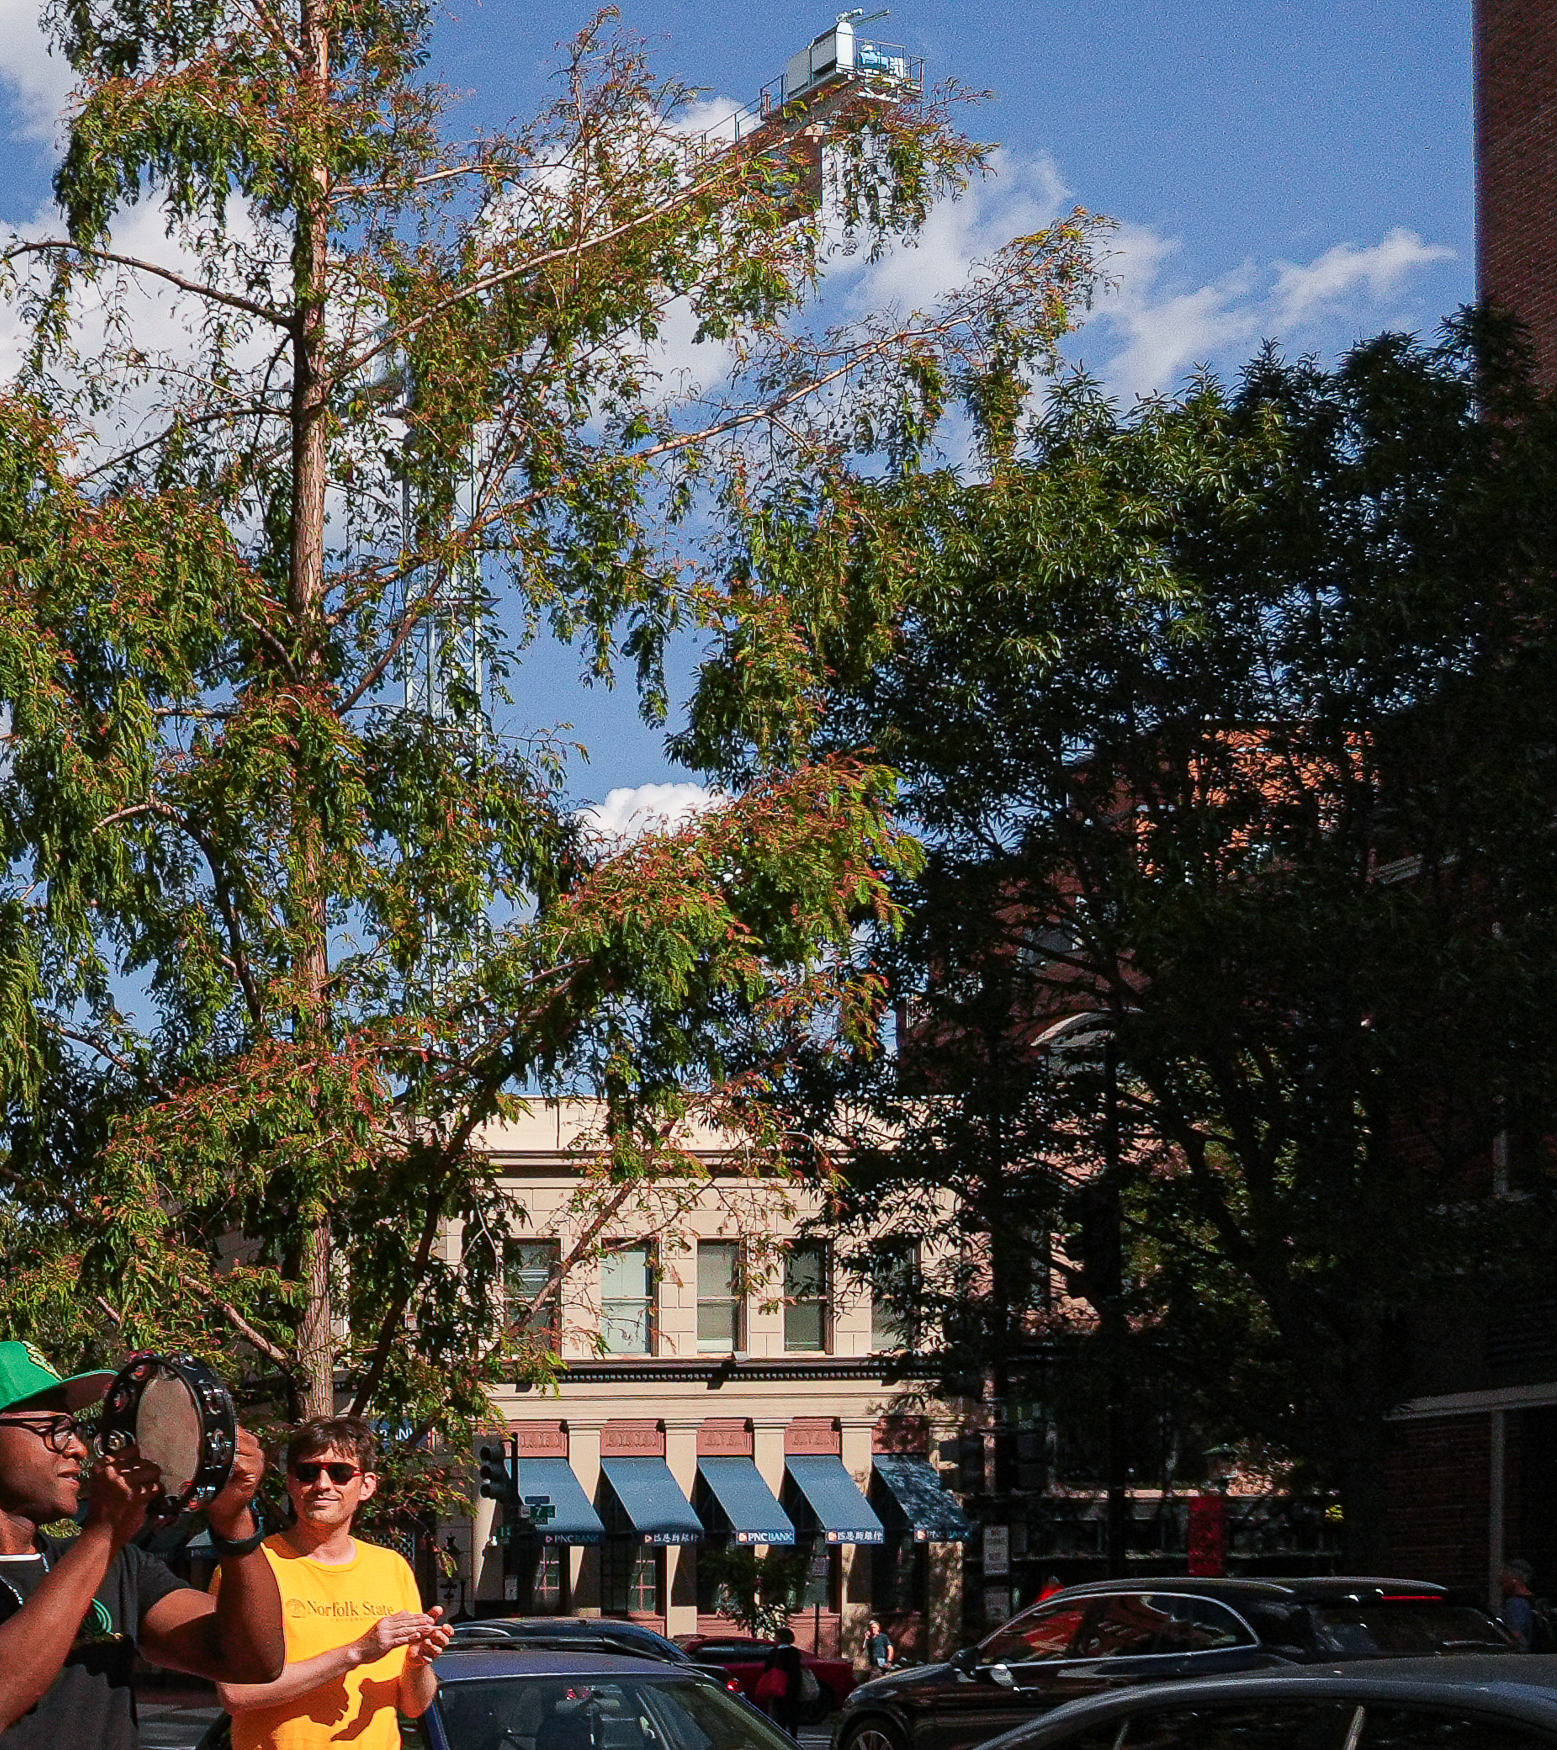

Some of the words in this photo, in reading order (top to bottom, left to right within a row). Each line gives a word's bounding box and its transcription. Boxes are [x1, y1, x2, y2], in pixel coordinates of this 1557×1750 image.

[554, 1534, 574, 1543] PNC
[575, 1534, 599, 1543] BANK
[747, 1532, 768, 1542] PNC
[768, 1532, 794, 1542] BANK
[306, 1599, 359, 1617] Norfolk
[362, 1600, 395, 1616] State
